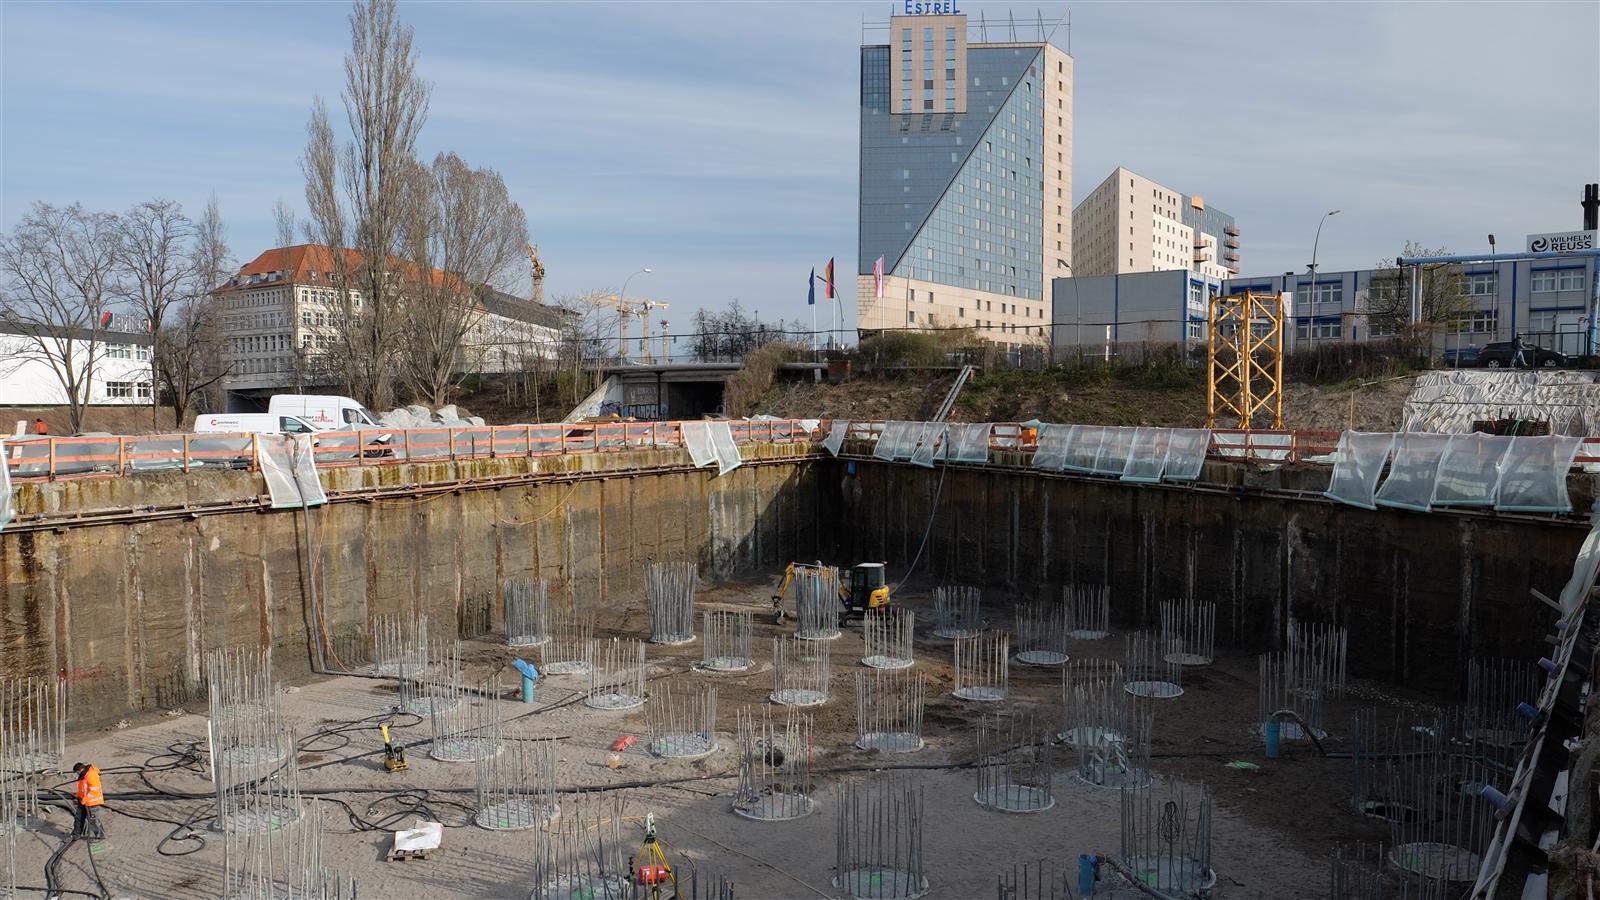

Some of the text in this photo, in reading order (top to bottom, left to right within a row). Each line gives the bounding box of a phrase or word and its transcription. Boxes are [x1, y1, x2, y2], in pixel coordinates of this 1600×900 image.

[905, 0, 961, 14] ESTREL
[1550, 234, 1592, 243] WILHELM
[1551, 241, 1592, 251] REUSS
